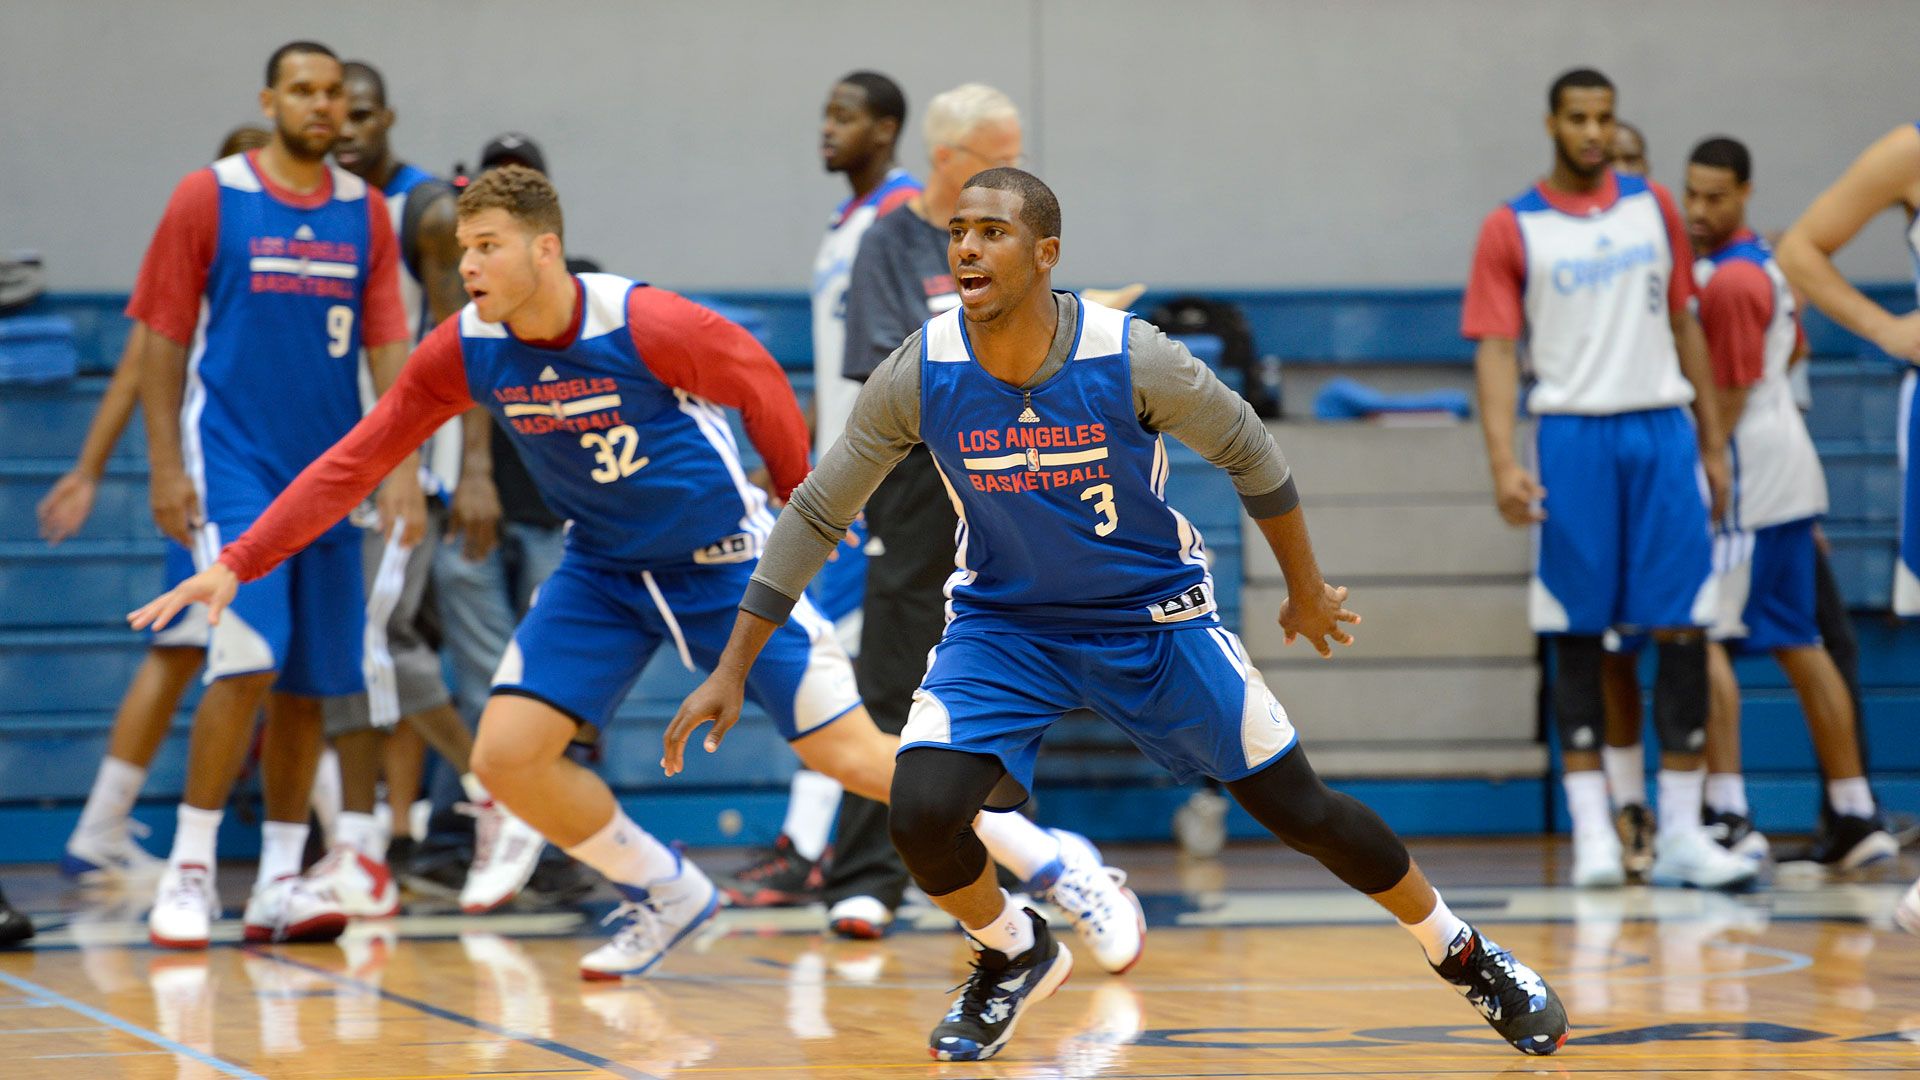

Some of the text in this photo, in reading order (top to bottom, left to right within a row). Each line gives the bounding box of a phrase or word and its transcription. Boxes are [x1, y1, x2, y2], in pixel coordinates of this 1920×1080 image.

[250, 236, 357, 262] LOS ANGELES
[251, 273, 354, 299] BASKETBALL
[328, 305, 354, 358] 9
[494, 377, 618, 403] LOS ANGELES
[511, 410, 625, 434] BASKETBALL
[958, 423, 1107, 453] LOS ANGELES
[580, 424, 649, 484] 32
[969, 464, 1110, 494] BASKETBALL
[1080, 483, 1119, 537] 3
